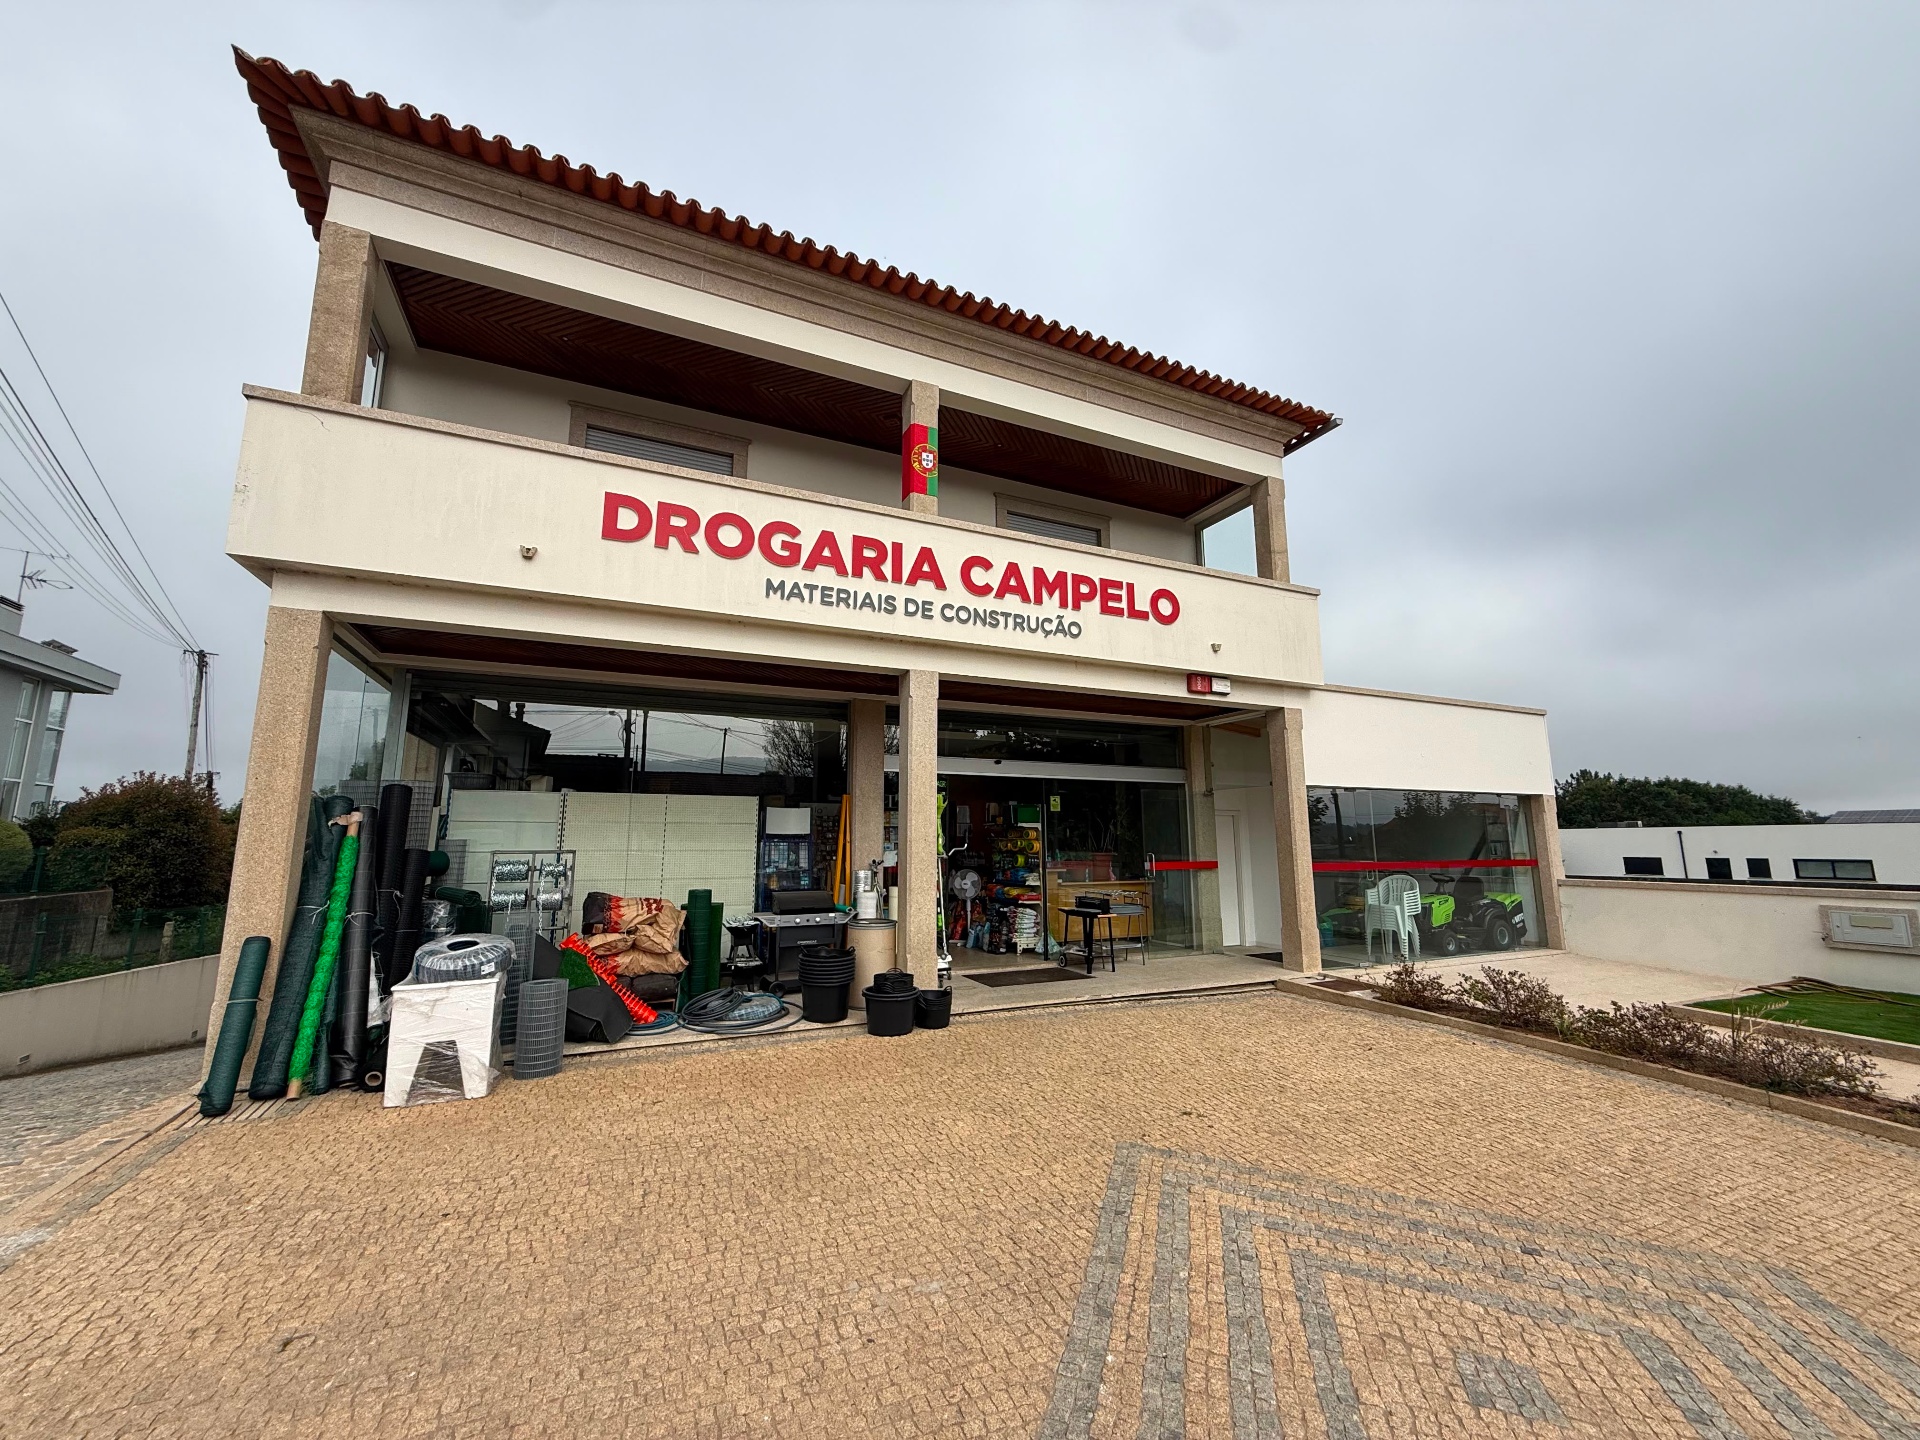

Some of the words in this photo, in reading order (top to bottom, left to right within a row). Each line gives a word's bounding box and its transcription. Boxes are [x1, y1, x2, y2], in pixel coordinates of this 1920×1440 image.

[601, 492, 947, 590] DROGARIA
[959, 555, 1181, 625] CAMPELO
[765, 577, 897, 615] MATERIAIS
[903, 597, 935, 620] DE
[940, 603, 1082, 640] CONSTRUÇÃO
